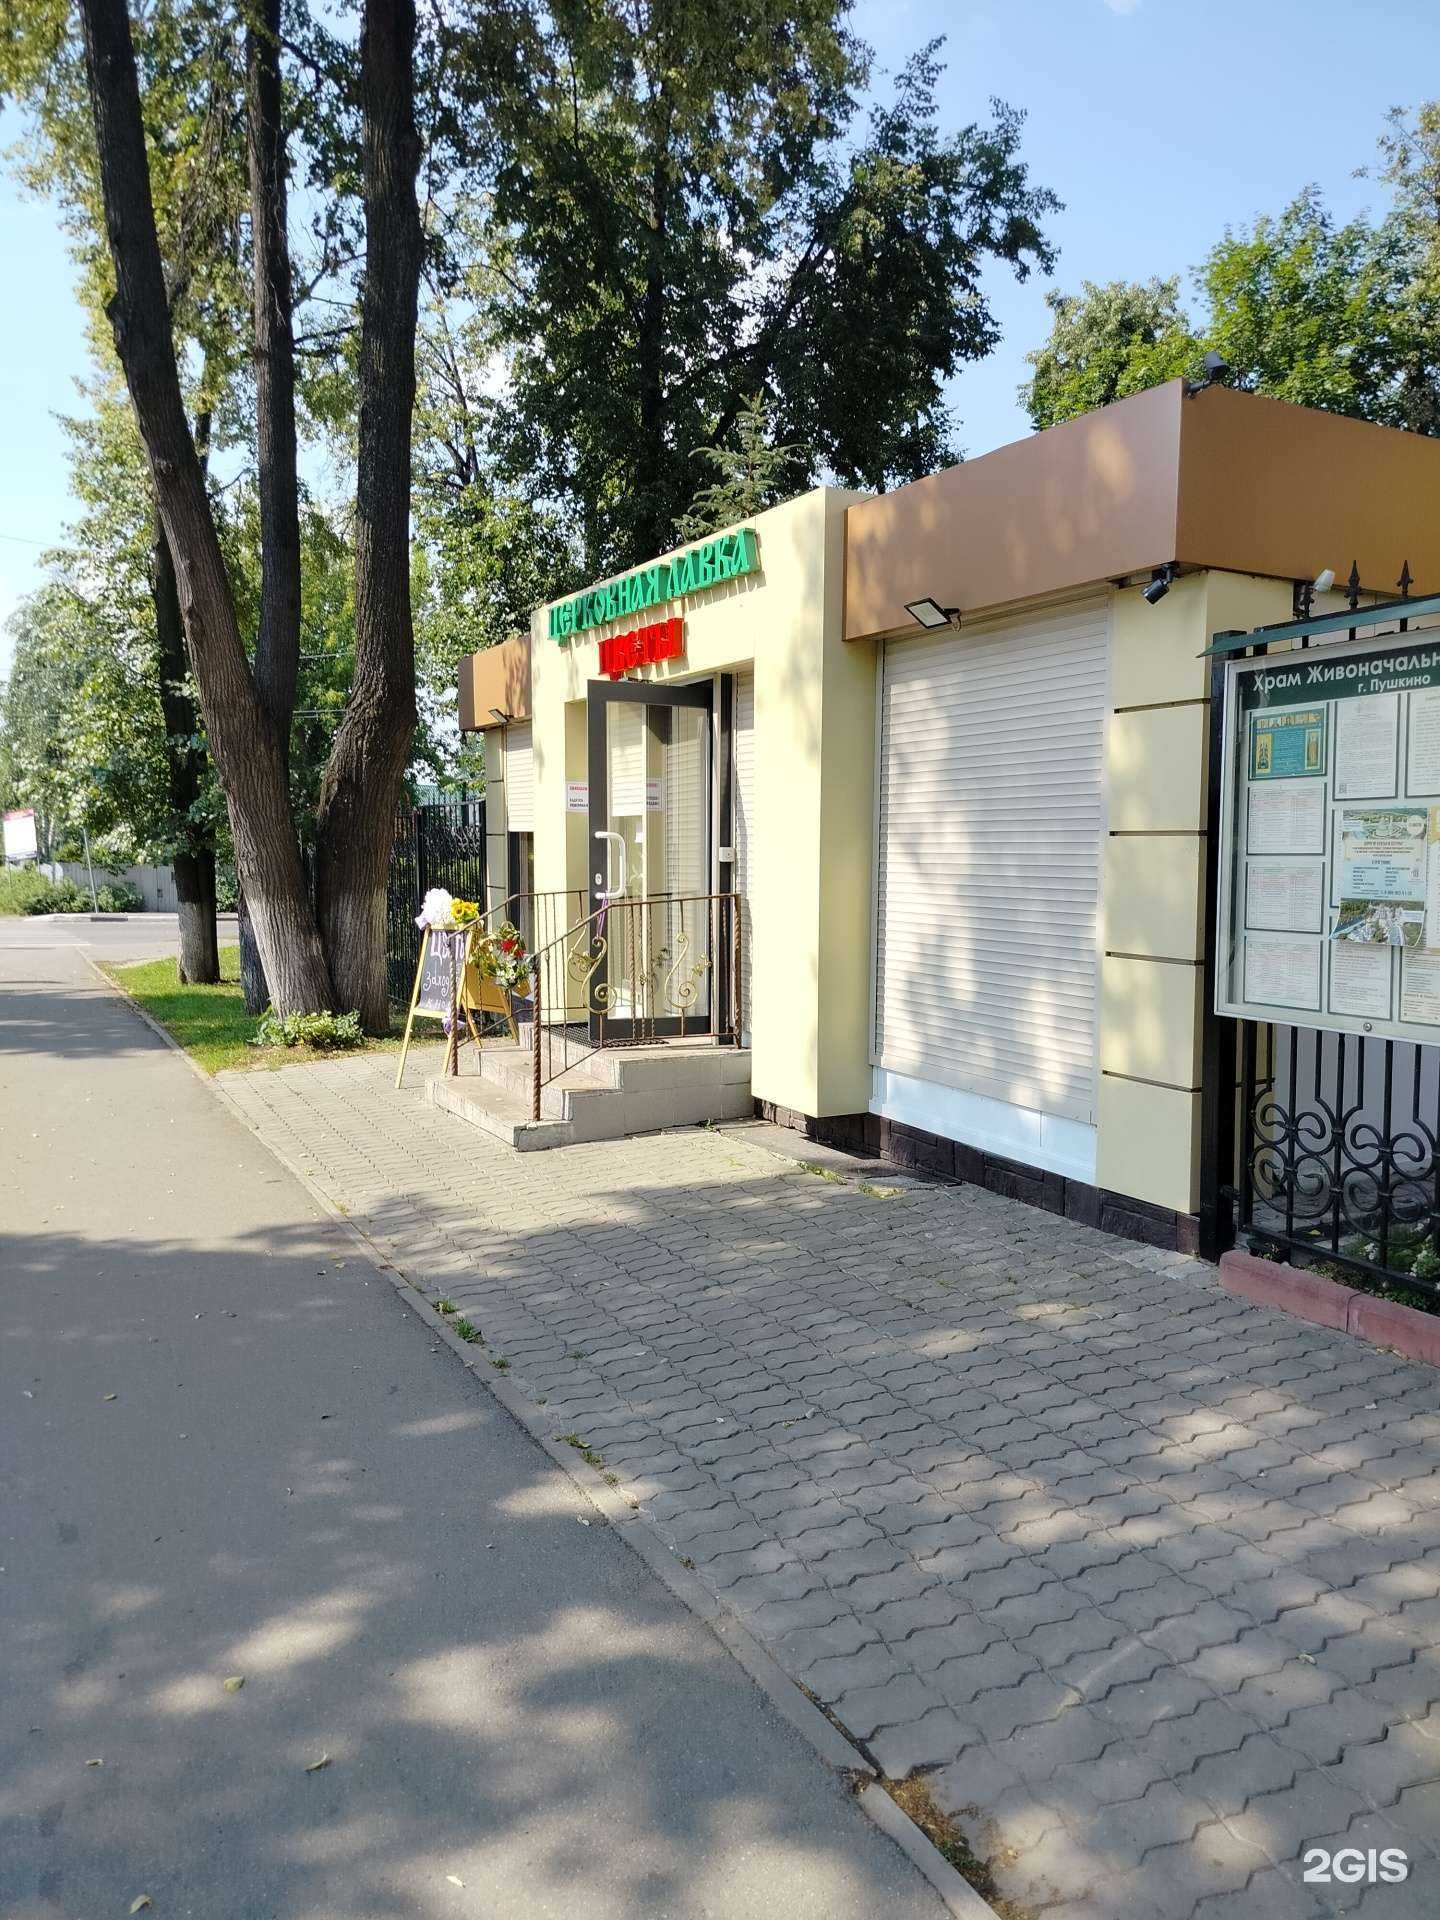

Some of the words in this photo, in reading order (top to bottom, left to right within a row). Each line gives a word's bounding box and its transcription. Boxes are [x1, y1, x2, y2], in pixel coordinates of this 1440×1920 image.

[548, 564, 667, 646] ЦЕРКОВНАЯ
[667, 528, 757, 600] ЛАВКА
[1253, 672, 1301, 694] Храм
[1357, 682, 1367, 693] г.
[1370, 674, 1431, 692] Пушкино
